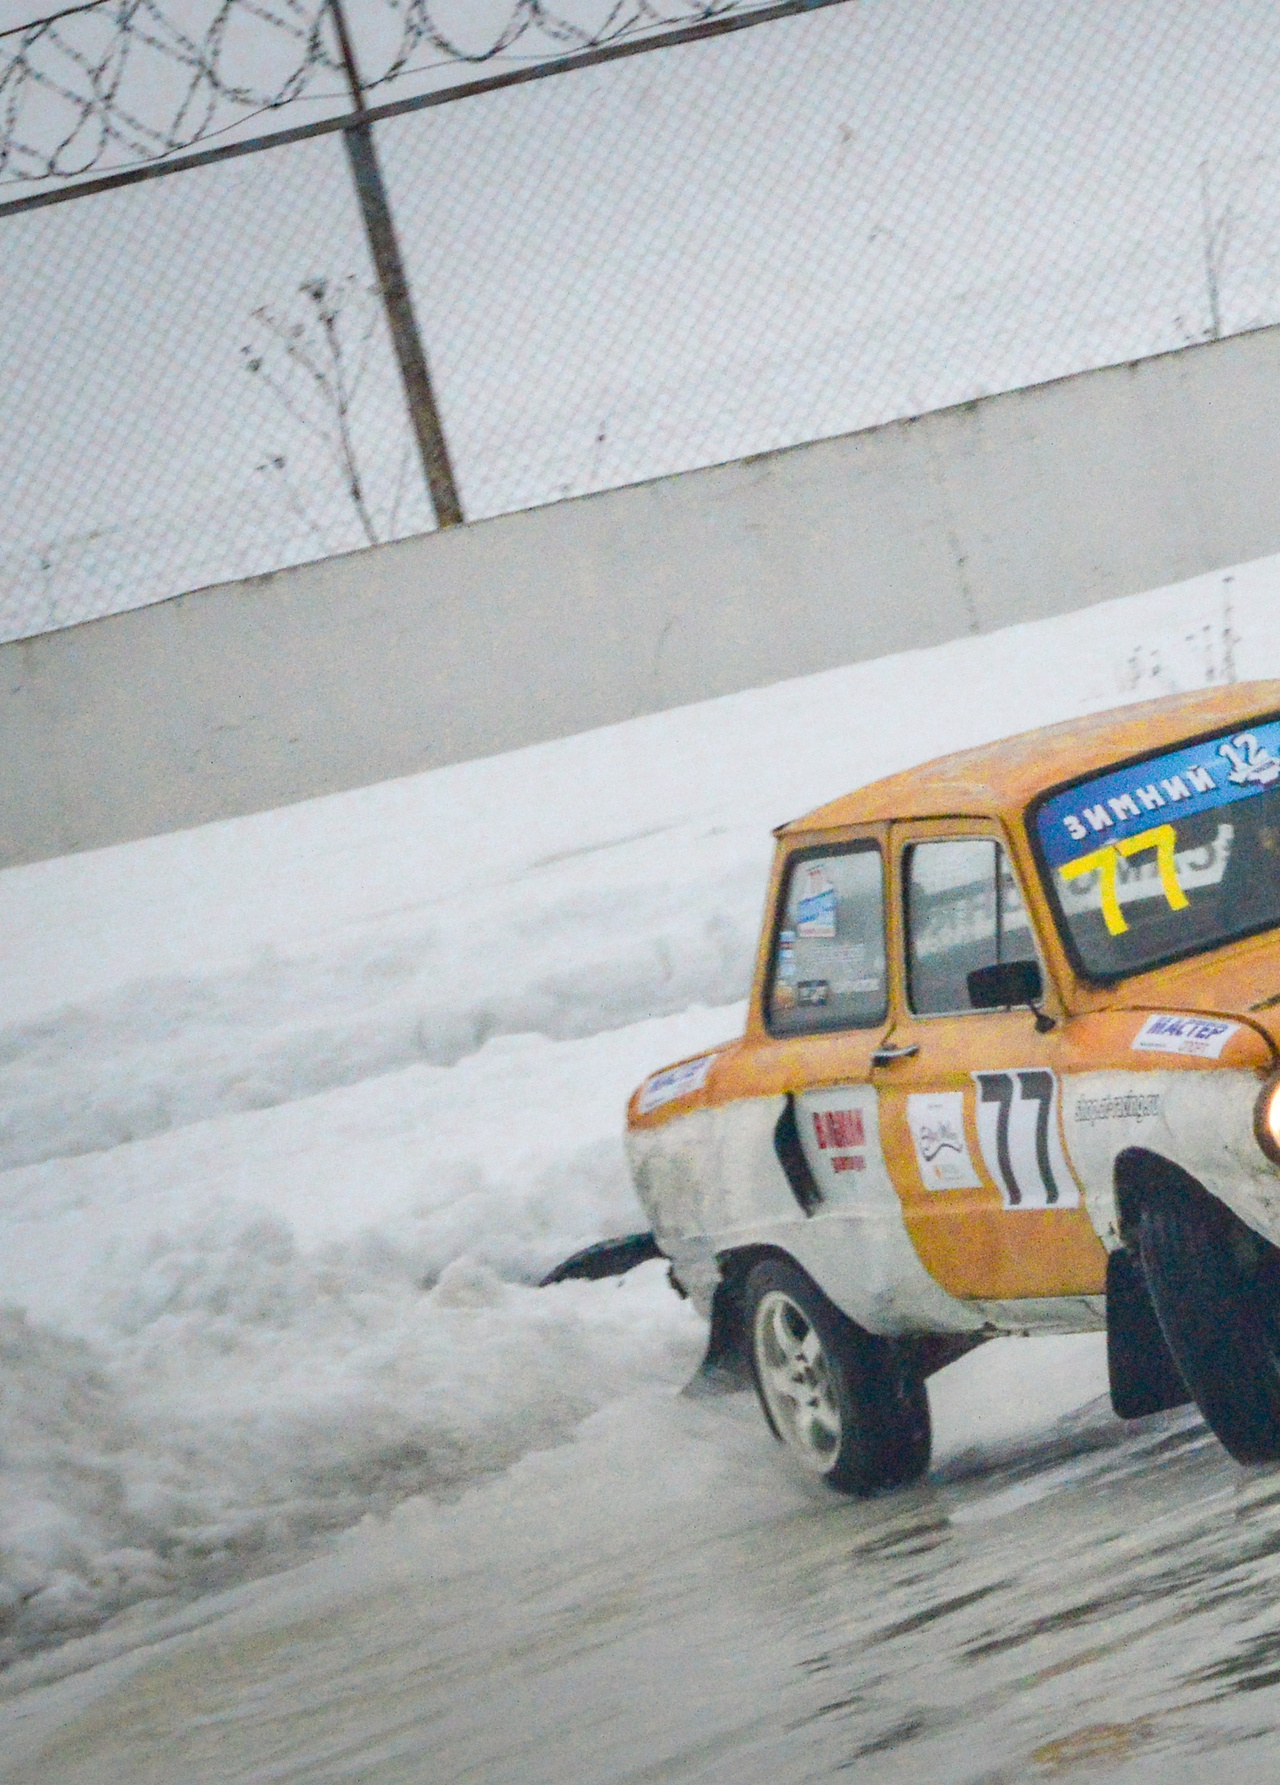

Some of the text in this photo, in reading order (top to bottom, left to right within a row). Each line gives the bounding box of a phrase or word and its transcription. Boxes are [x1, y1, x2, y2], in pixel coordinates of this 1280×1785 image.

[1062, 764, 1217, 841] ЗИМНИЙ
[1057, 823, 1190, 936] 77
[1146, 1016, 1230, 1040] МАСТЕР
[976, 1071, 1060, 1205] 77
